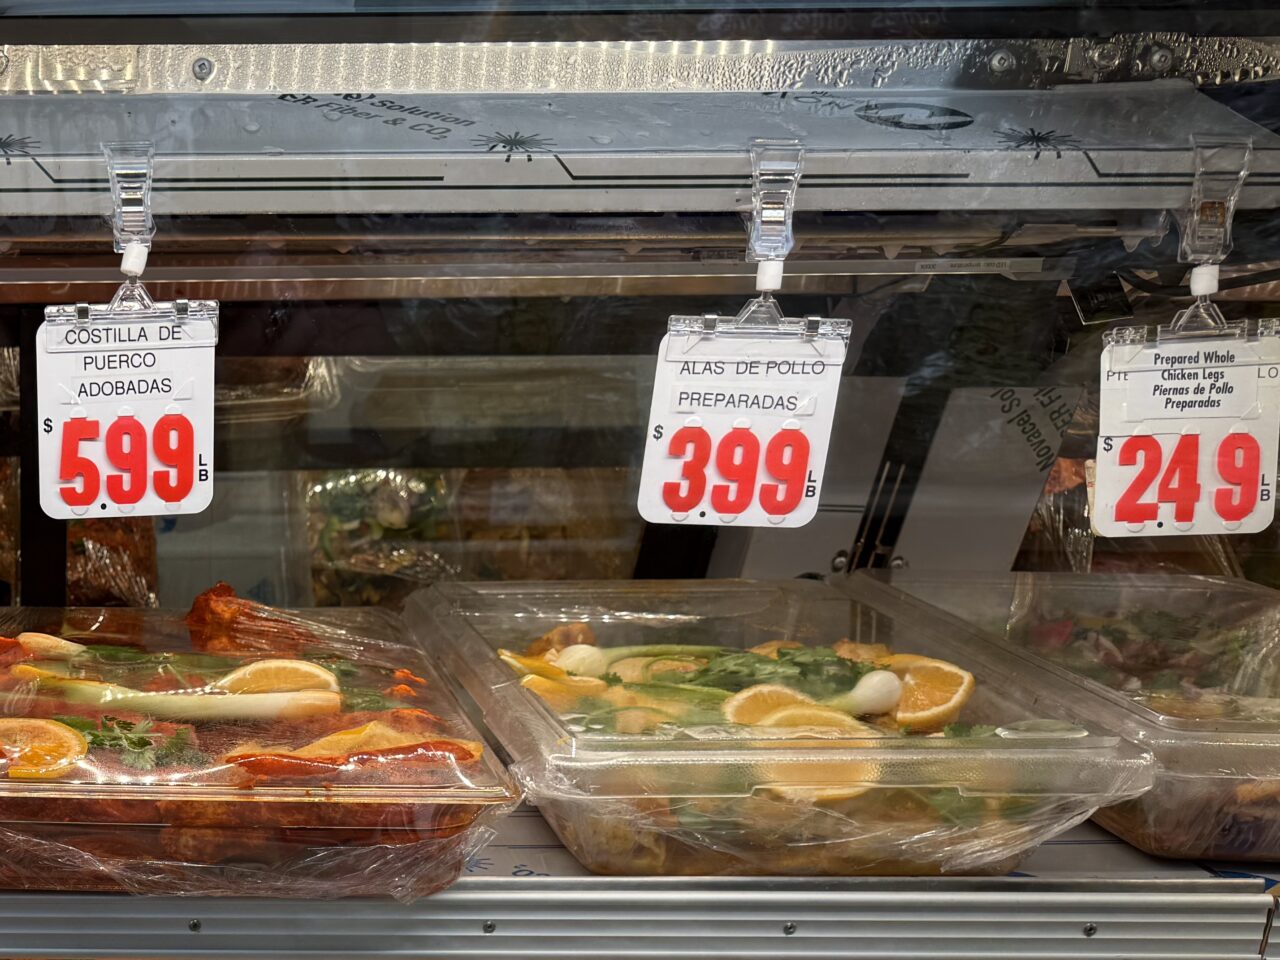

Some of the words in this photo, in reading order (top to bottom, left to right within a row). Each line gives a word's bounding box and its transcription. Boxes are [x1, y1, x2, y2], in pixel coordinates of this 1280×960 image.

[65, 327, 148, 345] COSTILLA
[158, 325, 182, 341] DE
[83, 352, 156, 371] PUERCO
[1154, 352, 1199, 367] Prepared
[1203, 350, 1235, 364] Whole
[679, 360, 725, 375] ALAS
[735, 361, 759, 375] DE
[765, 360, 825, 375] POLLO
[1161, 368, 1199, 381] Chicken
[1202, 368, 1225, 382] Legs
[77, 378, 172, 398] ADOBADAS
[1152, 384, 1190, 396] Piernas
[1193, 383, 1206, 395] de
[1209, 382, 1234, 394] Pollo
[678, 391, 798, 411] PREPARADAS
[1164, 397, 1221, 412] Preparadas
